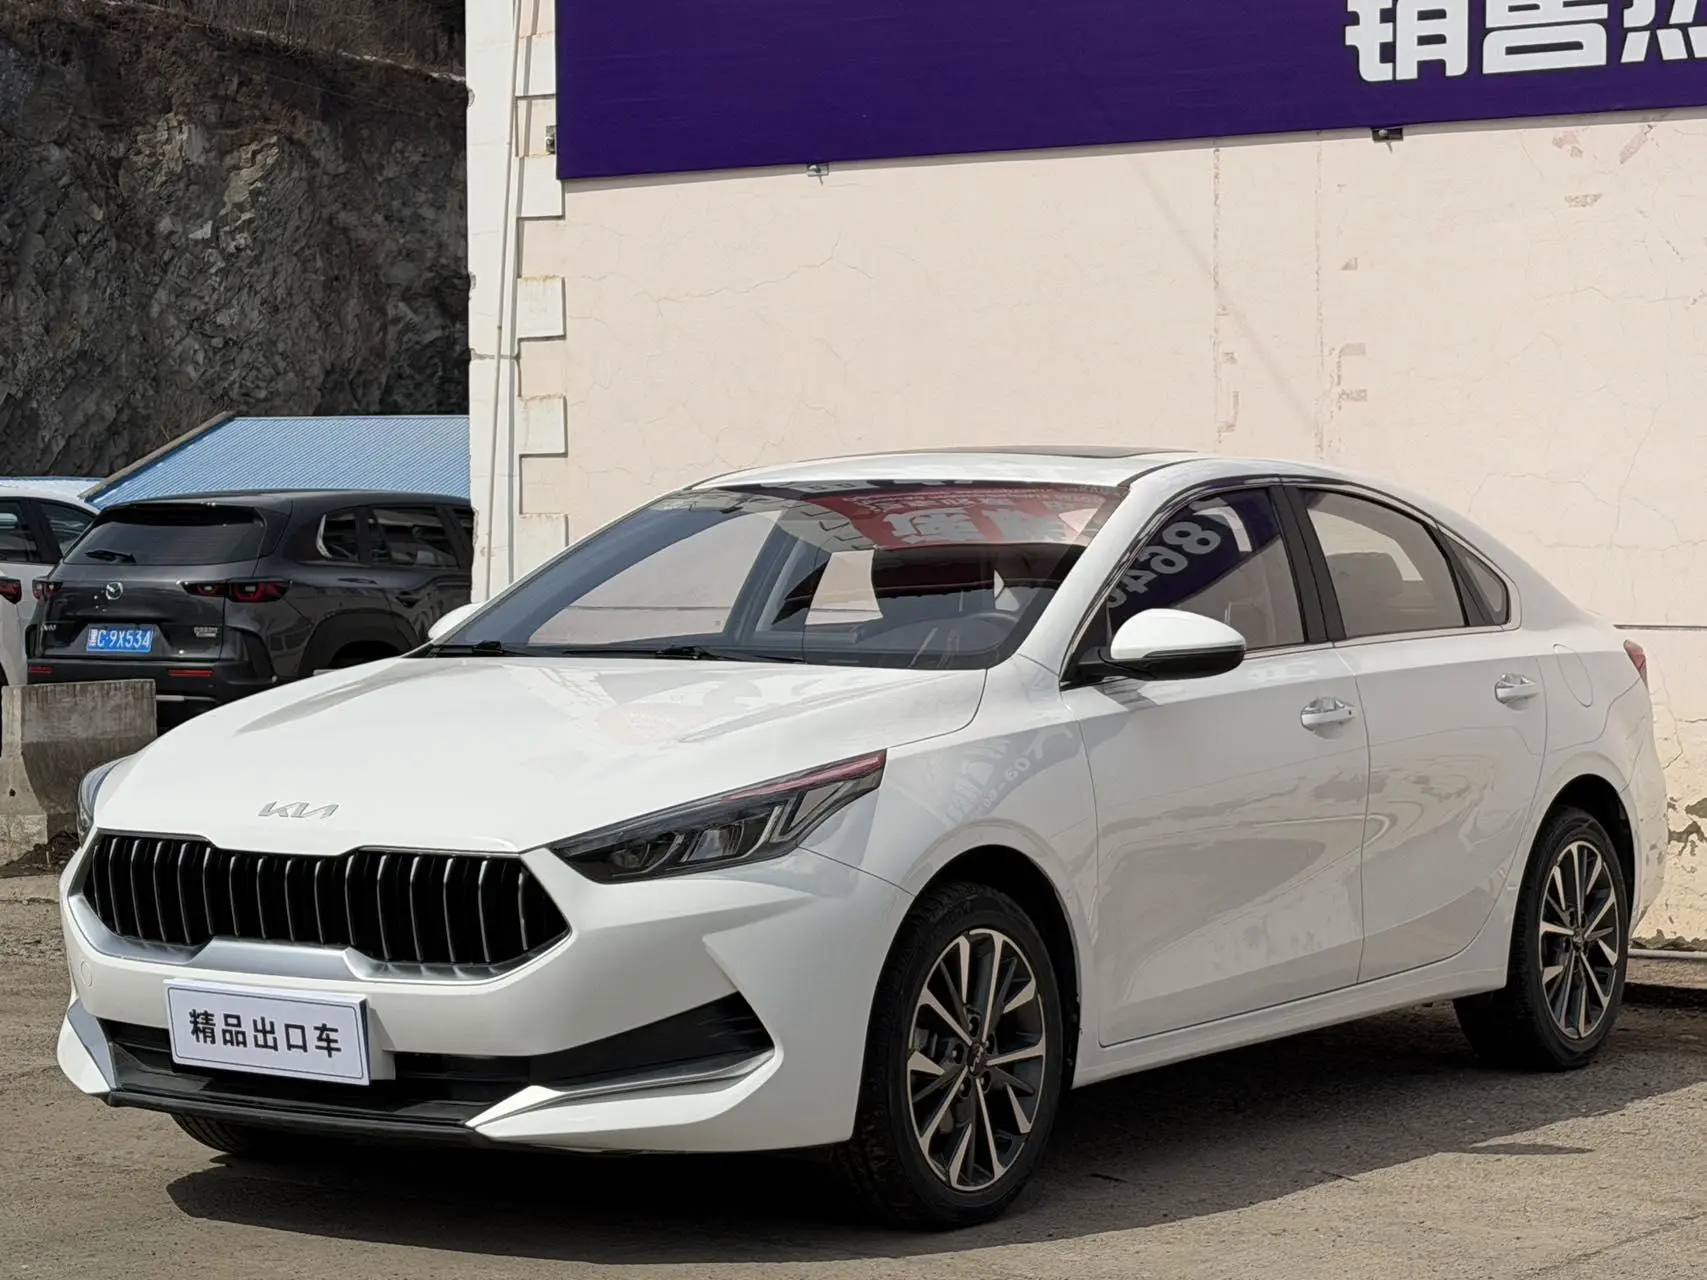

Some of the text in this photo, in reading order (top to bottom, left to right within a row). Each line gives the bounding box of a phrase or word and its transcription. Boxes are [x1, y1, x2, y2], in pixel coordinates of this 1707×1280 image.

[188, 1008, 342, 1058] 精品出口车
